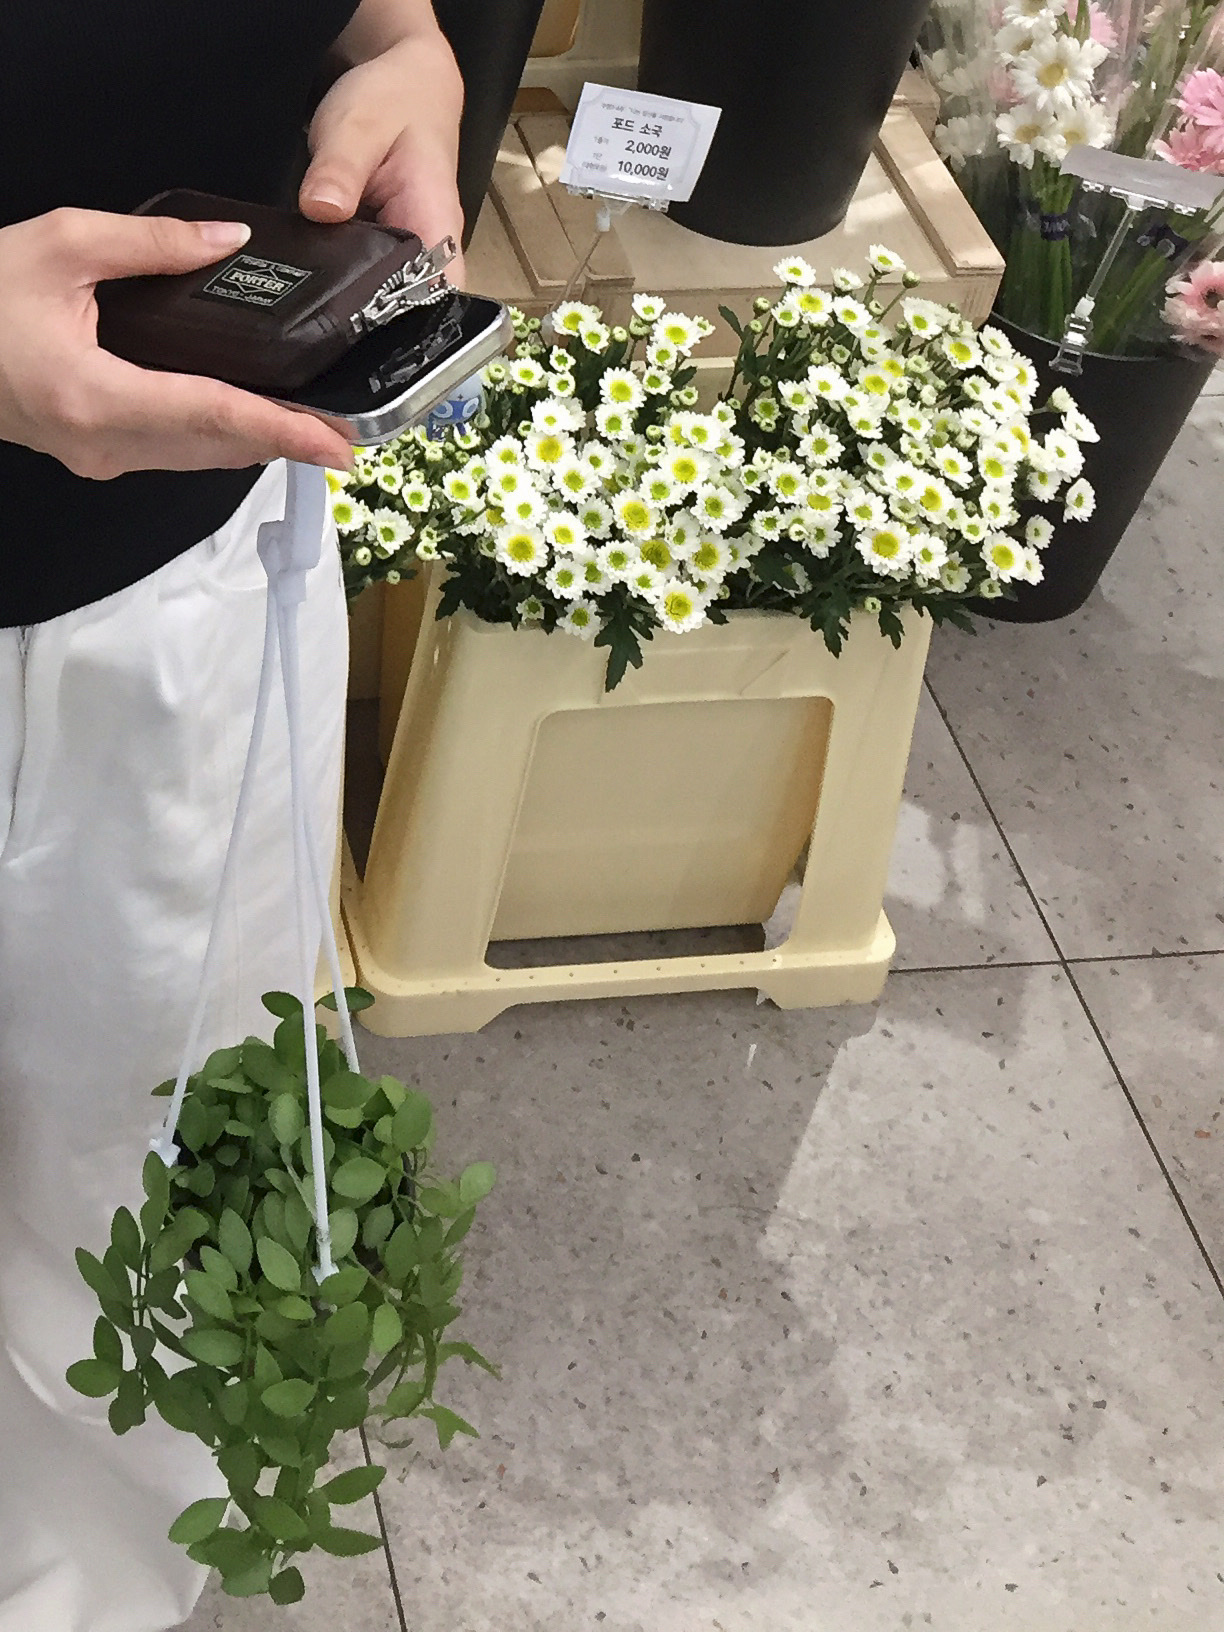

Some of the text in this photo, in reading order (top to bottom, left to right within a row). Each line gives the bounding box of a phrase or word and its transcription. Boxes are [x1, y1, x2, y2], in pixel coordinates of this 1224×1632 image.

[611, 117, 663, 138] 포드 소국
[625, 139, 672, 160] 2,000원
[617, 160, 669, 181] 10,000원
[229, 271, 285, 291] PORTER
